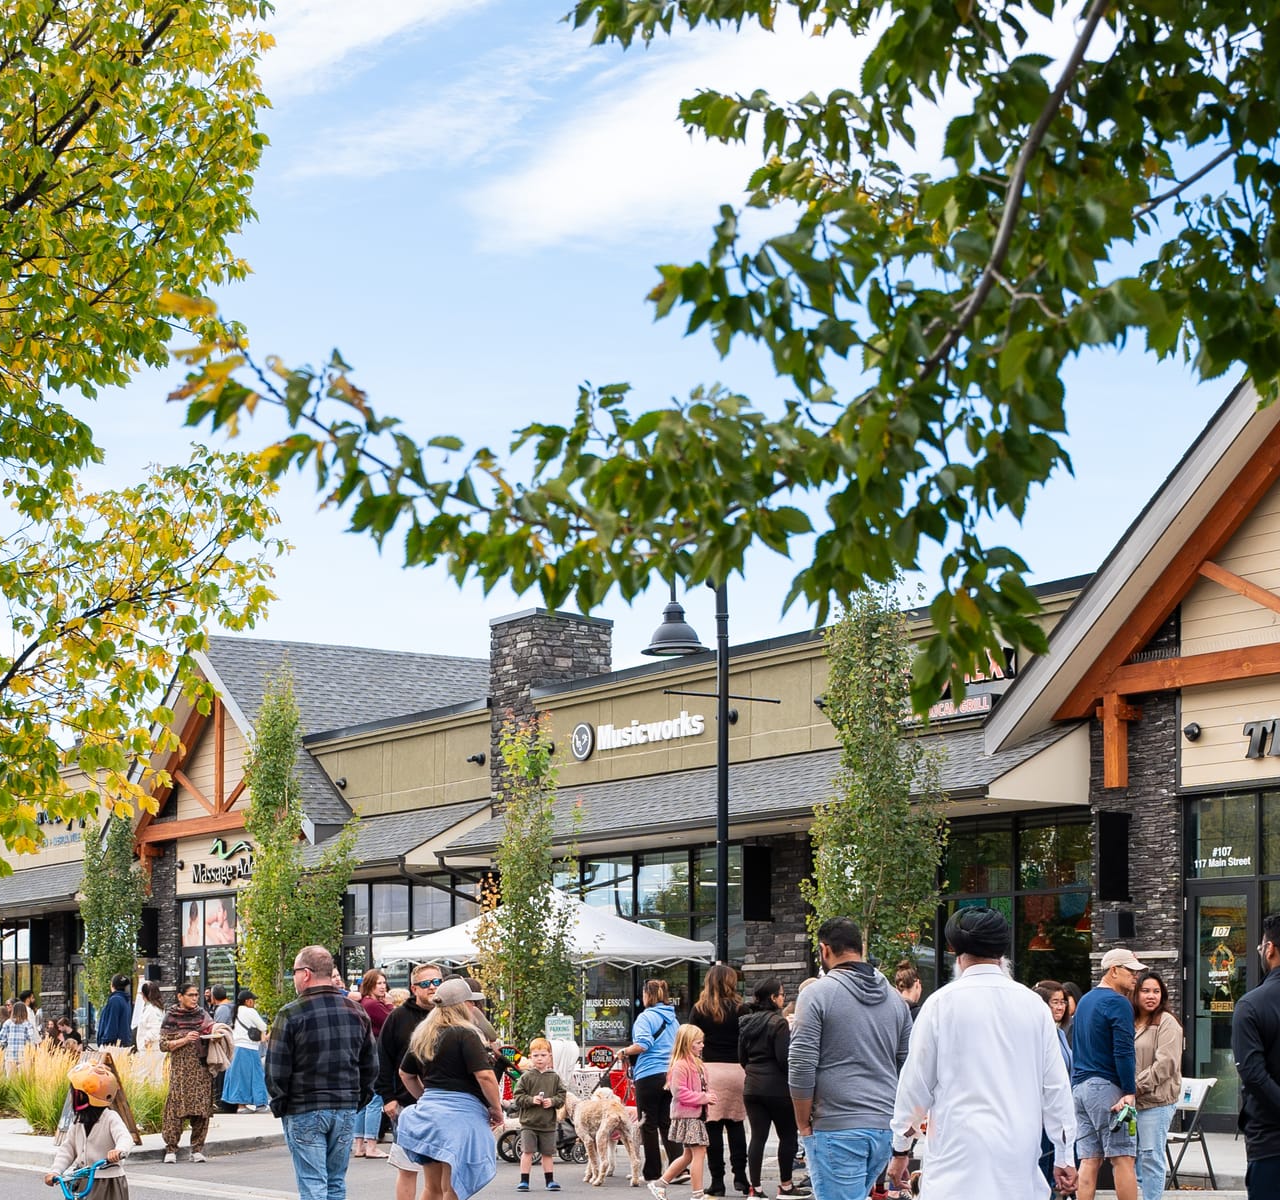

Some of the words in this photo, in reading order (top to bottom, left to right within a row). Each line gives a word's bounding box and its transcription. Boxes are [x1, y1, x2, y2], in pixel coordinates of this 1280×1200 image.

[959, 697, 990, 714] GRILL
[597, 710, 705, 750] Musicworks
[1212, 847, 1232, 857] #107
[1194, 860, 1207, 868] 117
[1208, 859, 1226, 867] Main
[1228, 856, 1251, 866] Street
[192, 863, 236, 885] Massage
[1213, 927, 1230, 936] 107
[586, 999, 603, 1007] MUSIC
[604, 998, 630, 1007] LESSONS
[591, 1020, 624, 1029] PRESCHOOL
